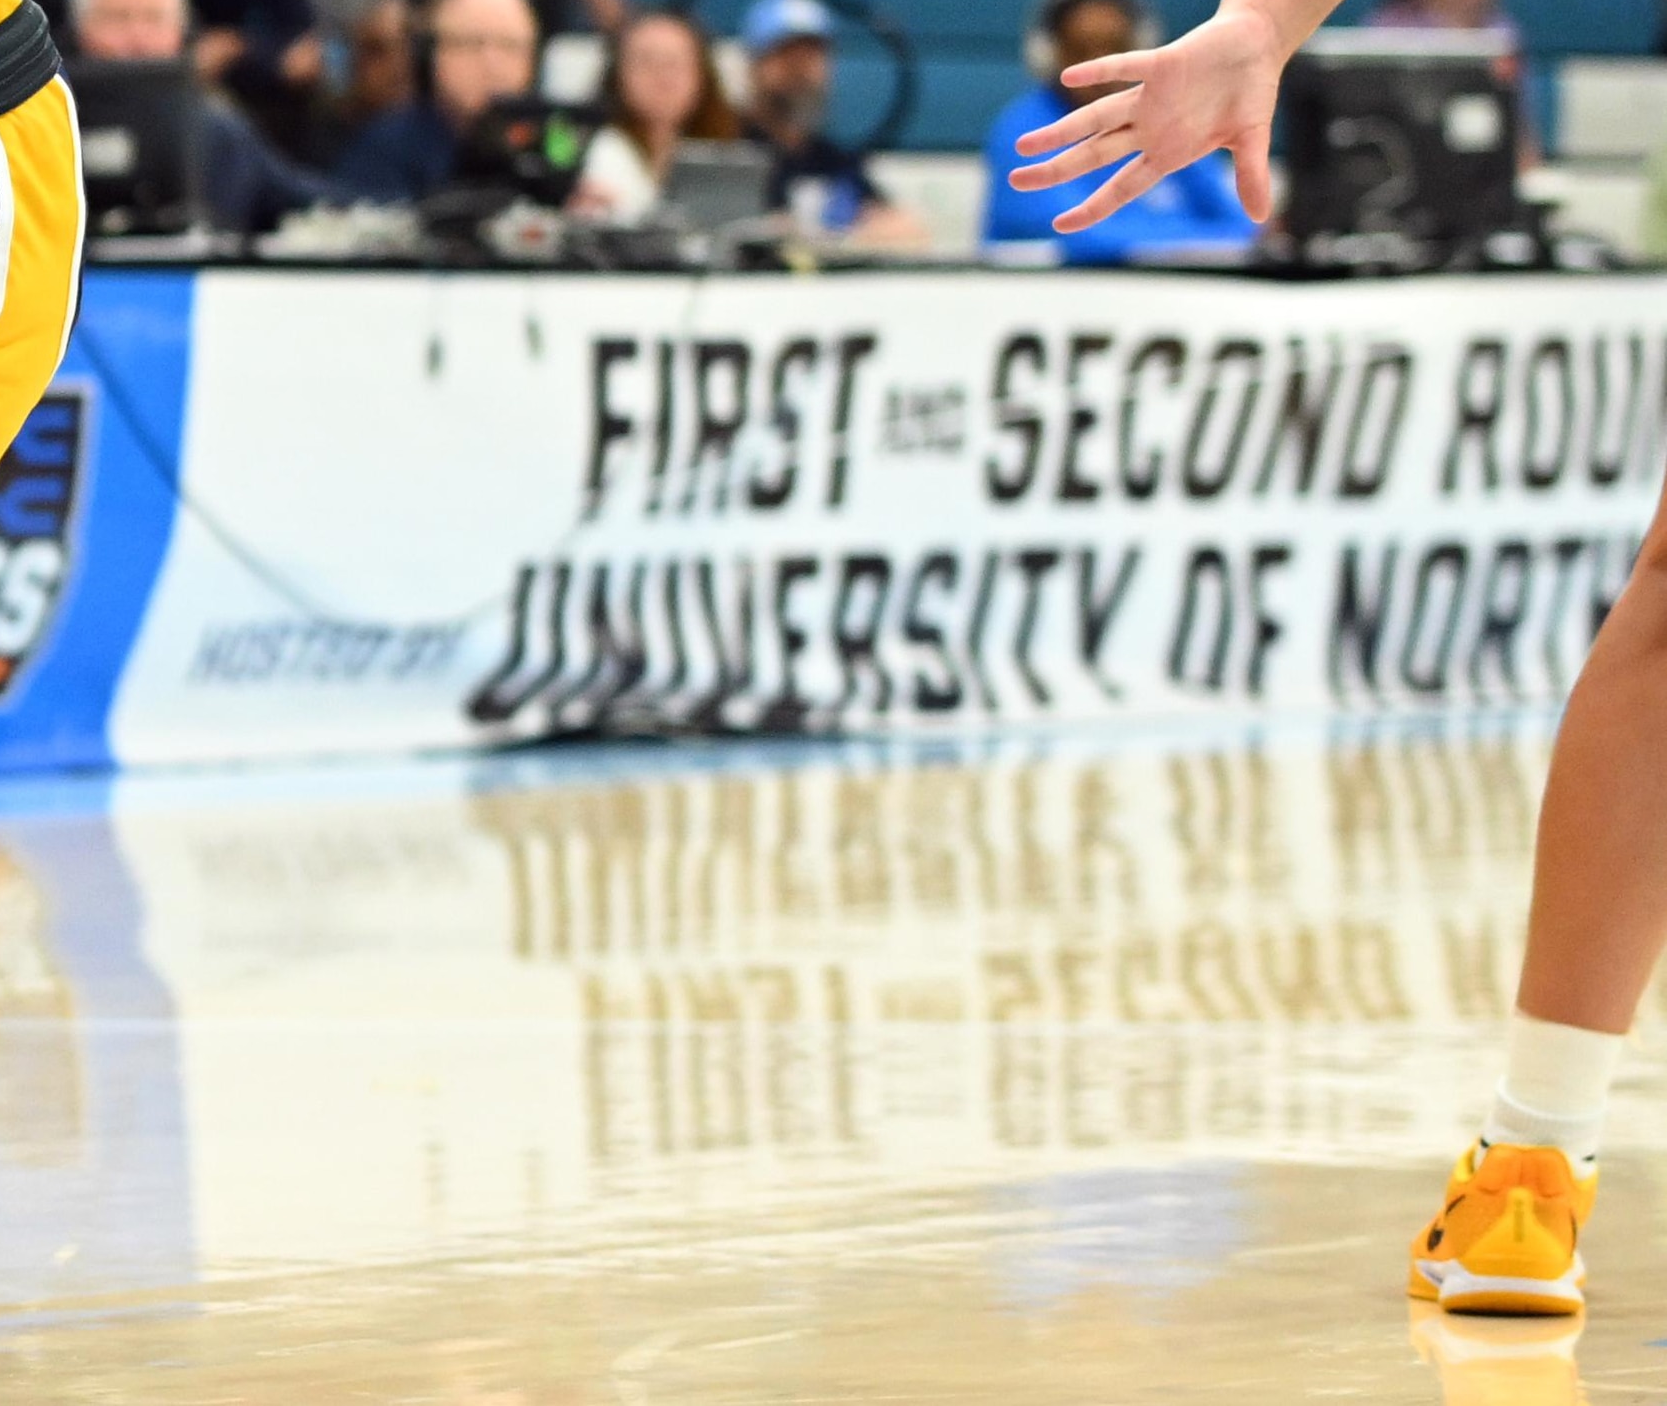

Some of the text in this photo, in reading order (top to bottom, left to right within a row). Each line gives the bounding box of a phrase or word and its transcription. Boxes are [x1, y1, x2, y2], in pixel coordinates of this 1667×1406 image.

[579, 330, 879, 522] FIRST
[983, 326, 1417, 506] SECOND
[465, 542, 1142, 729] UNIVERSITY
[1162, 538, 1297, 702] OF
